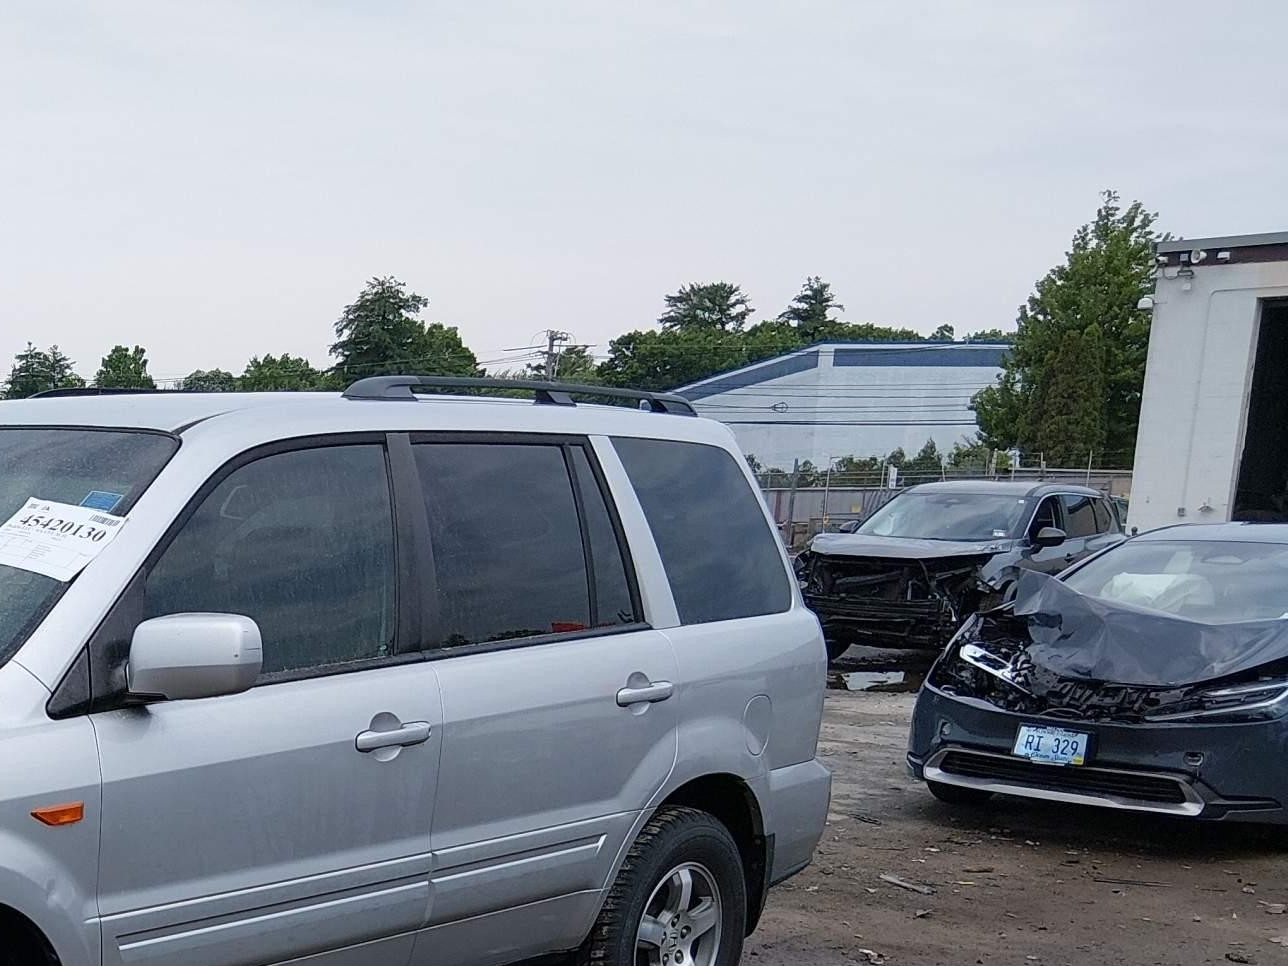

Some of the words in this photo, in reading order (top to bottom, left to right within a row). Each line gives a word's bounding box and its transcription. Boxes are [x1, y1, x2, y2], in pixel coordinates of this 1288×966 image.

[19, 514, 107, 543] 45420130
[1024, 734, 1044, 752] RI
[1051, 737, 1079, 756] 329
